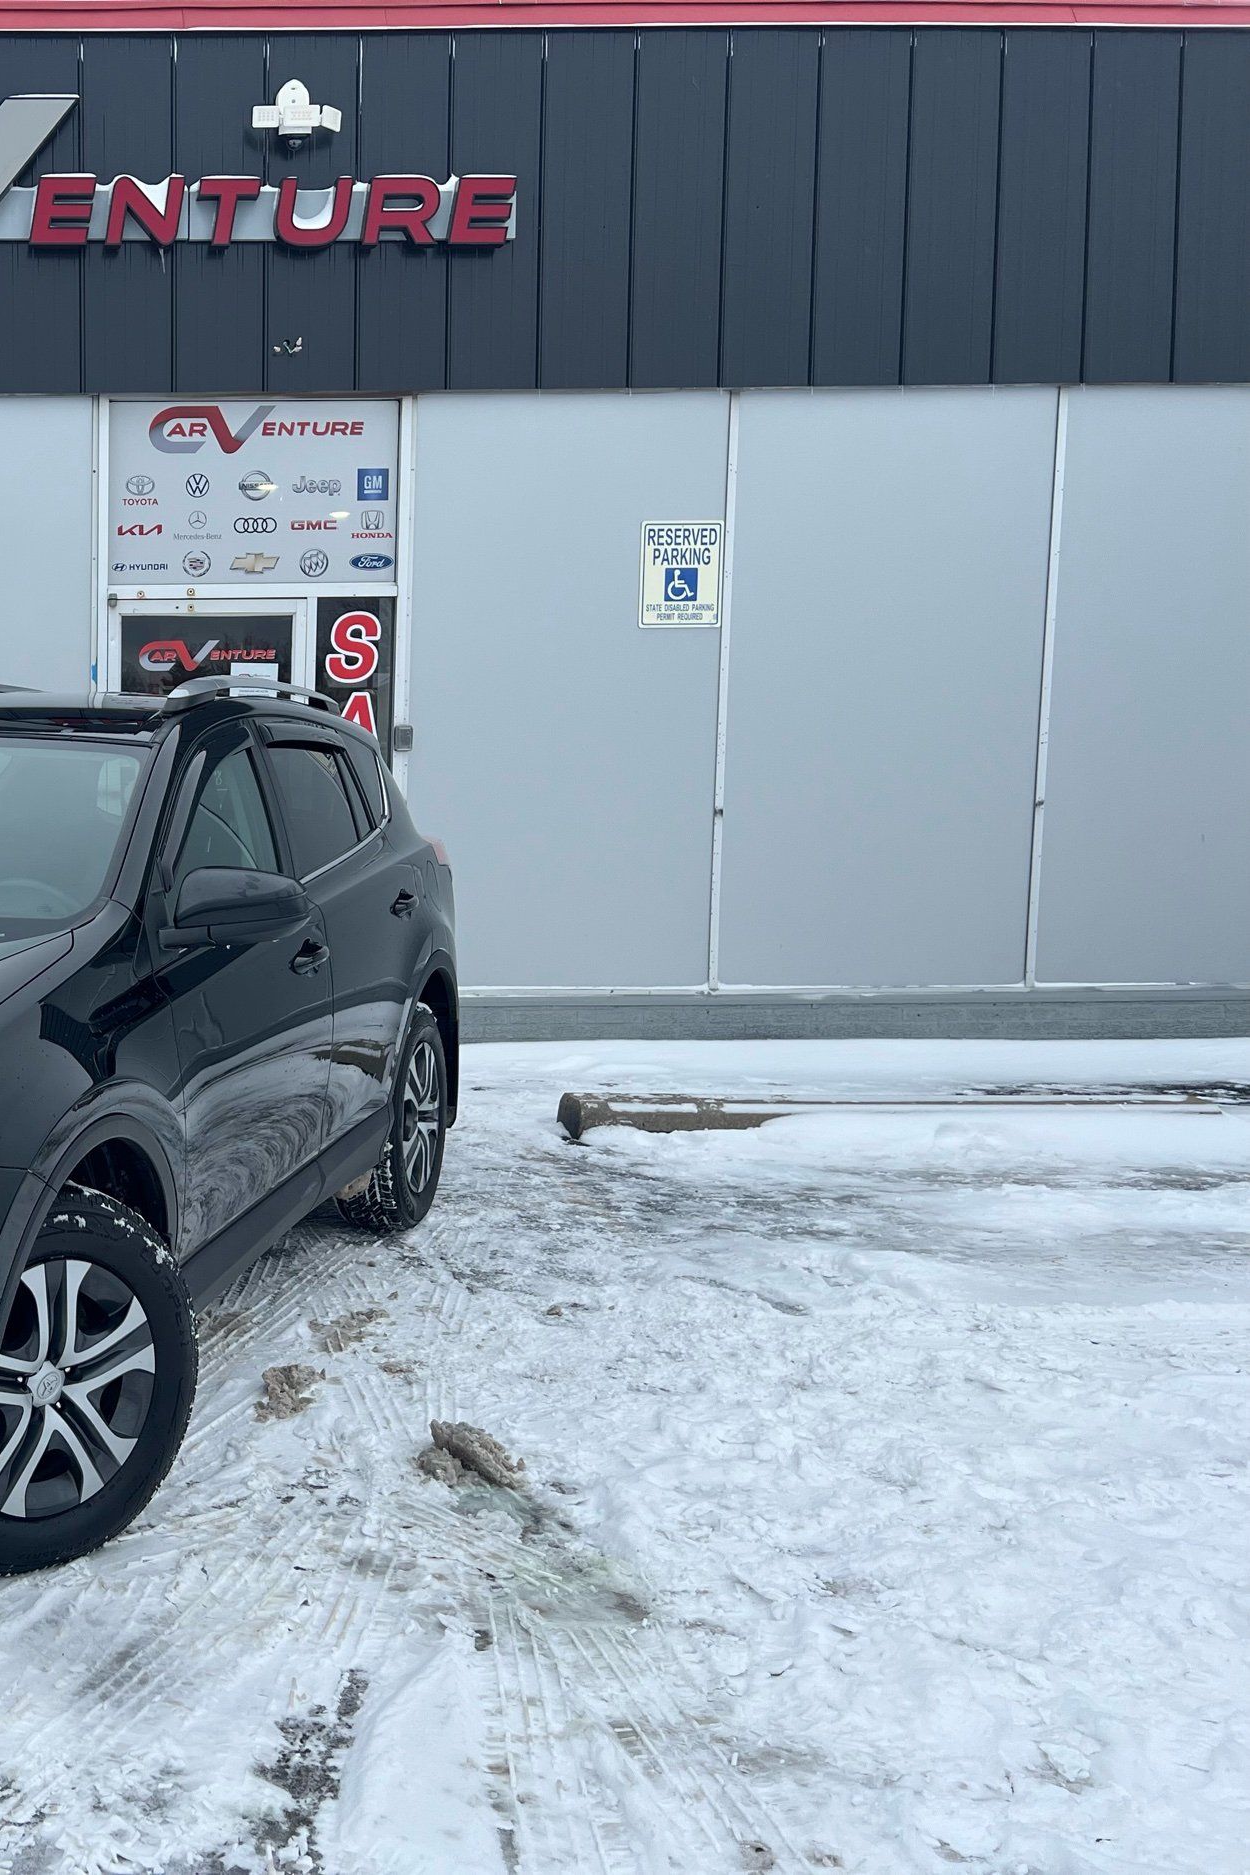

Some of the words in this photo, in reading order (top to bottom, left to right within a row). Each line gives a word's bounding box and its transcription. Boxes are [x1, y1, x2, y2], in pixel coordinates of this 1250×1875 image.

[291, 475, 342, 496] Jeep
[363, 475, 383, 490] GM
[122, 498, 159, 506] TOYOTA
[117, 524, 163, 536] KIA
[290, 520, 337, 531] GMC
[173, 533, 222, 541] Mercedes-Benz
[647, 528, 718, 546] RESERVED
[357, 554, 385, 568] Ford
[652, 547, 711, 566] PARKING
[128, 563, 169, 571] HYUNDAI
[646, 603, 663, 612] STATE
[664, 603, 690, 611] DISABLED
[691, 603, 715, 611] PARKING
